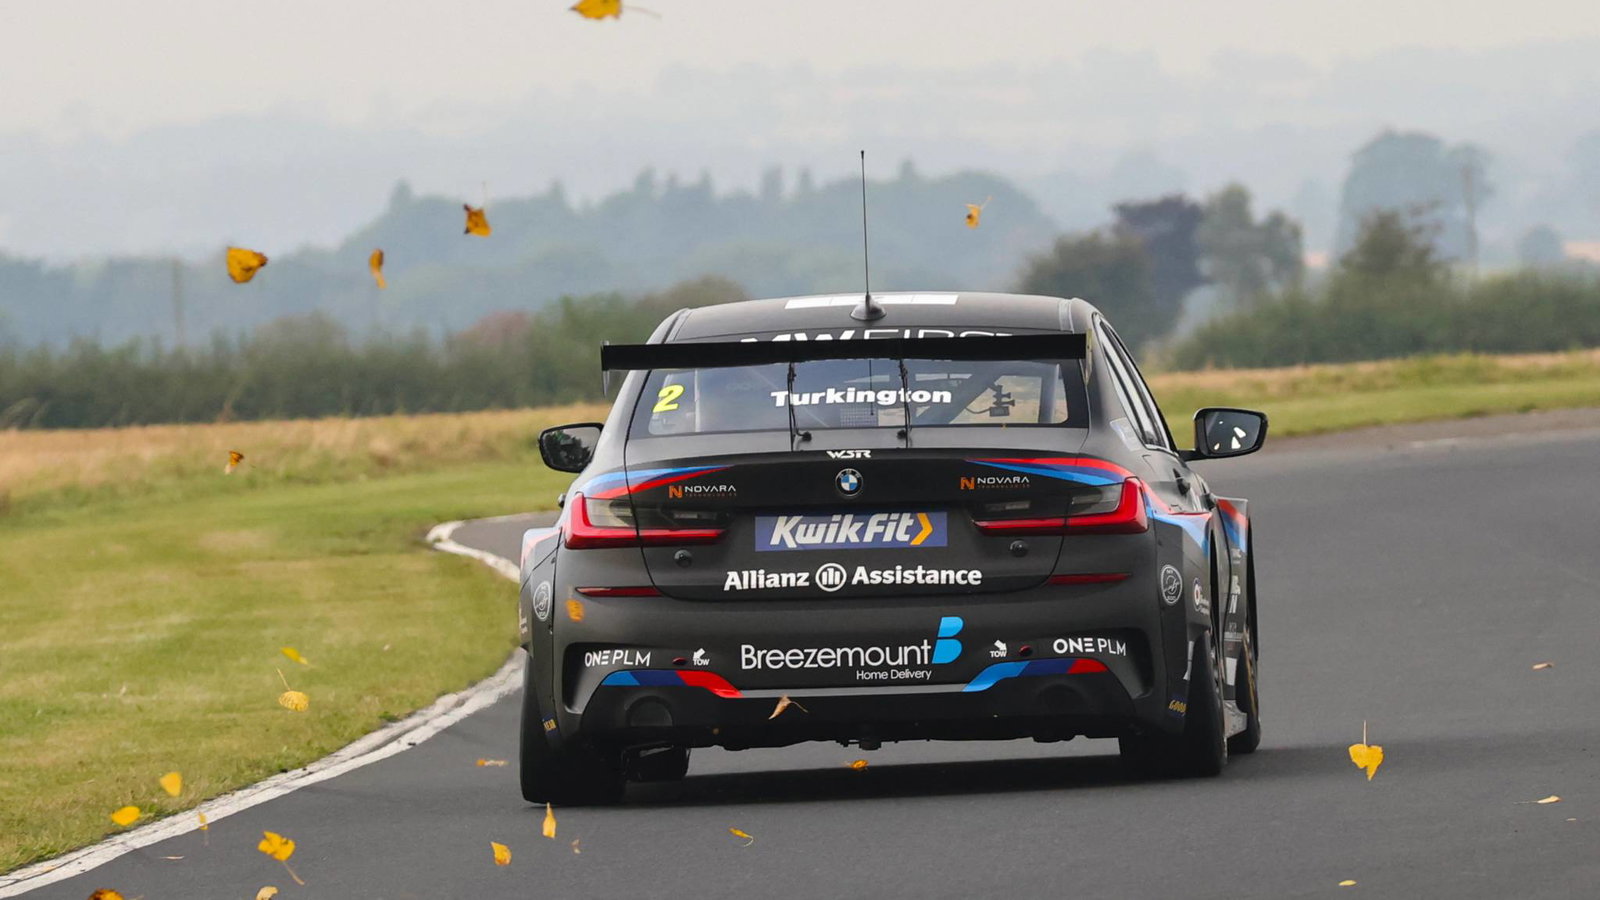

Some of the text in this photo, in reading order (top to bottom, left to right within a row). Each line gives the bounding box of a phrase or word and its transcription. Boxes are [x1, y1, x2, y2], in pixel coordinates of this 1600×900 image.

[652, 384, 684, 413] 2
[771, 387, 952, 407] Turkington
[826, 450, 872, 459] WSR
[977, 475, 1030, 484] NOVARA
[684, 484, 737, 493] NOVARA
[723, 565, 983, 591] Allianz Assistance
[740, 639, 932, 670] Breezemount
[989, 650, 1008, 658] TOW
[692, 658, 710, 666] TOW
[856, 668, 932, 681] Home Delivery
